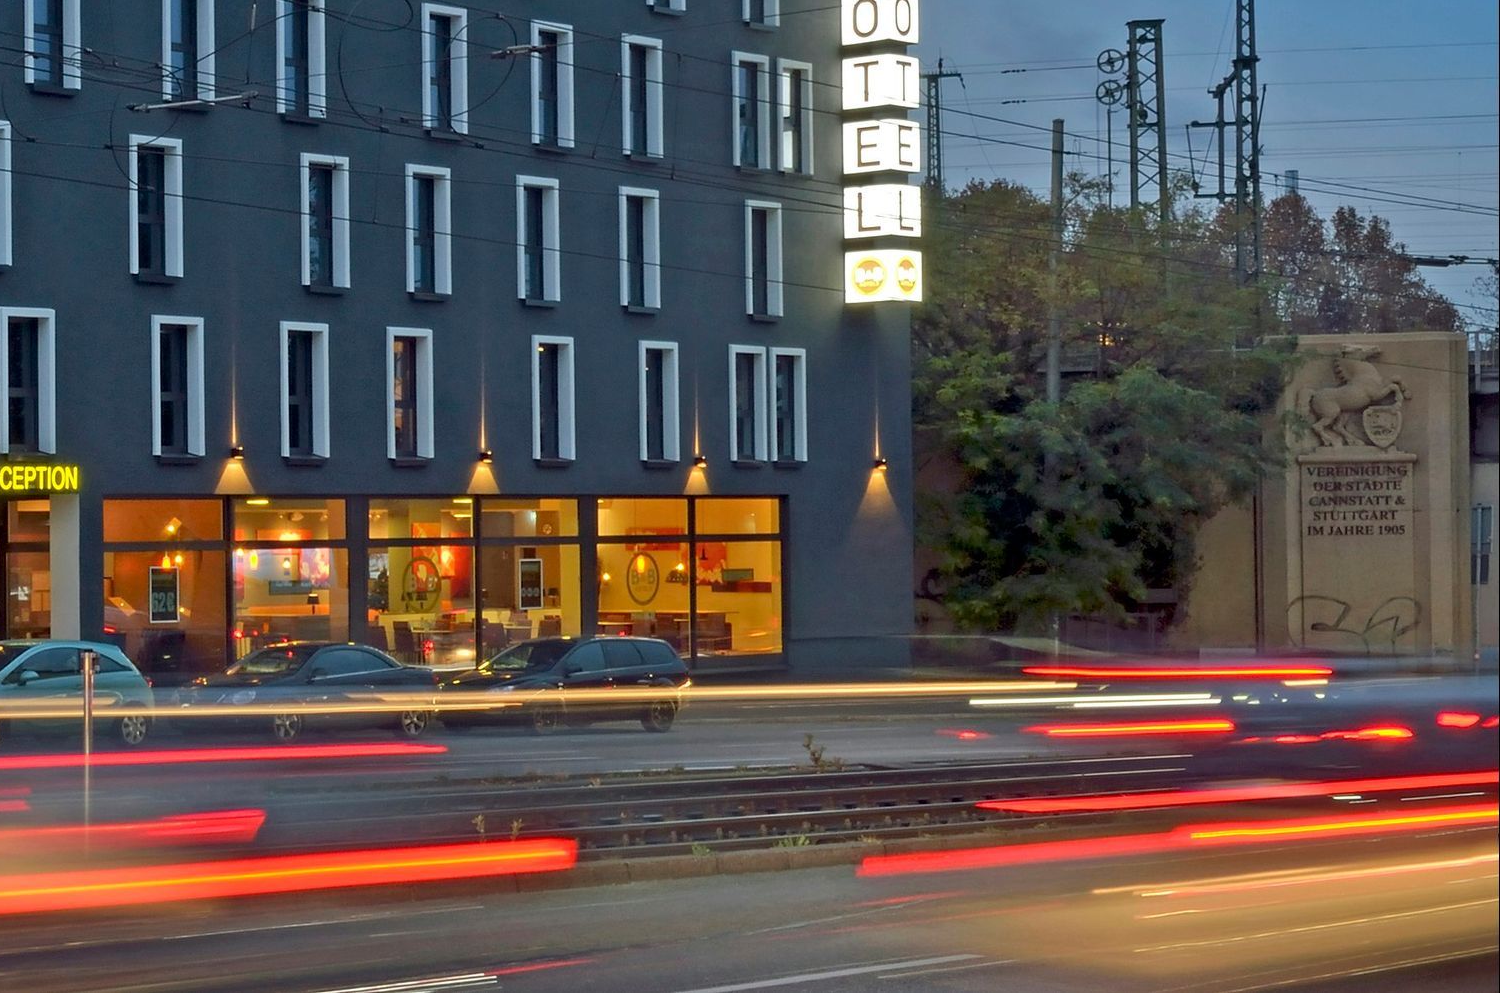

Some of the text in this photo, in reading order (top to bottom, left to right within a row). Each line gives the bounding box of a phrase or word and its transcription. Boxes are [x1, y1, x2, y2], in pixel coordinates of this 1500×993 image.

[1307, 466, 1408, 477] VEREINIGUNG
[1313, 481, 1341, 492] DER
[1309, 495, 1406, 506] CANNSTATT &
[1313, 509, 1398, 521] STUTTGART
[1307, 525, 1406, 536] IM JAHRE 1905
